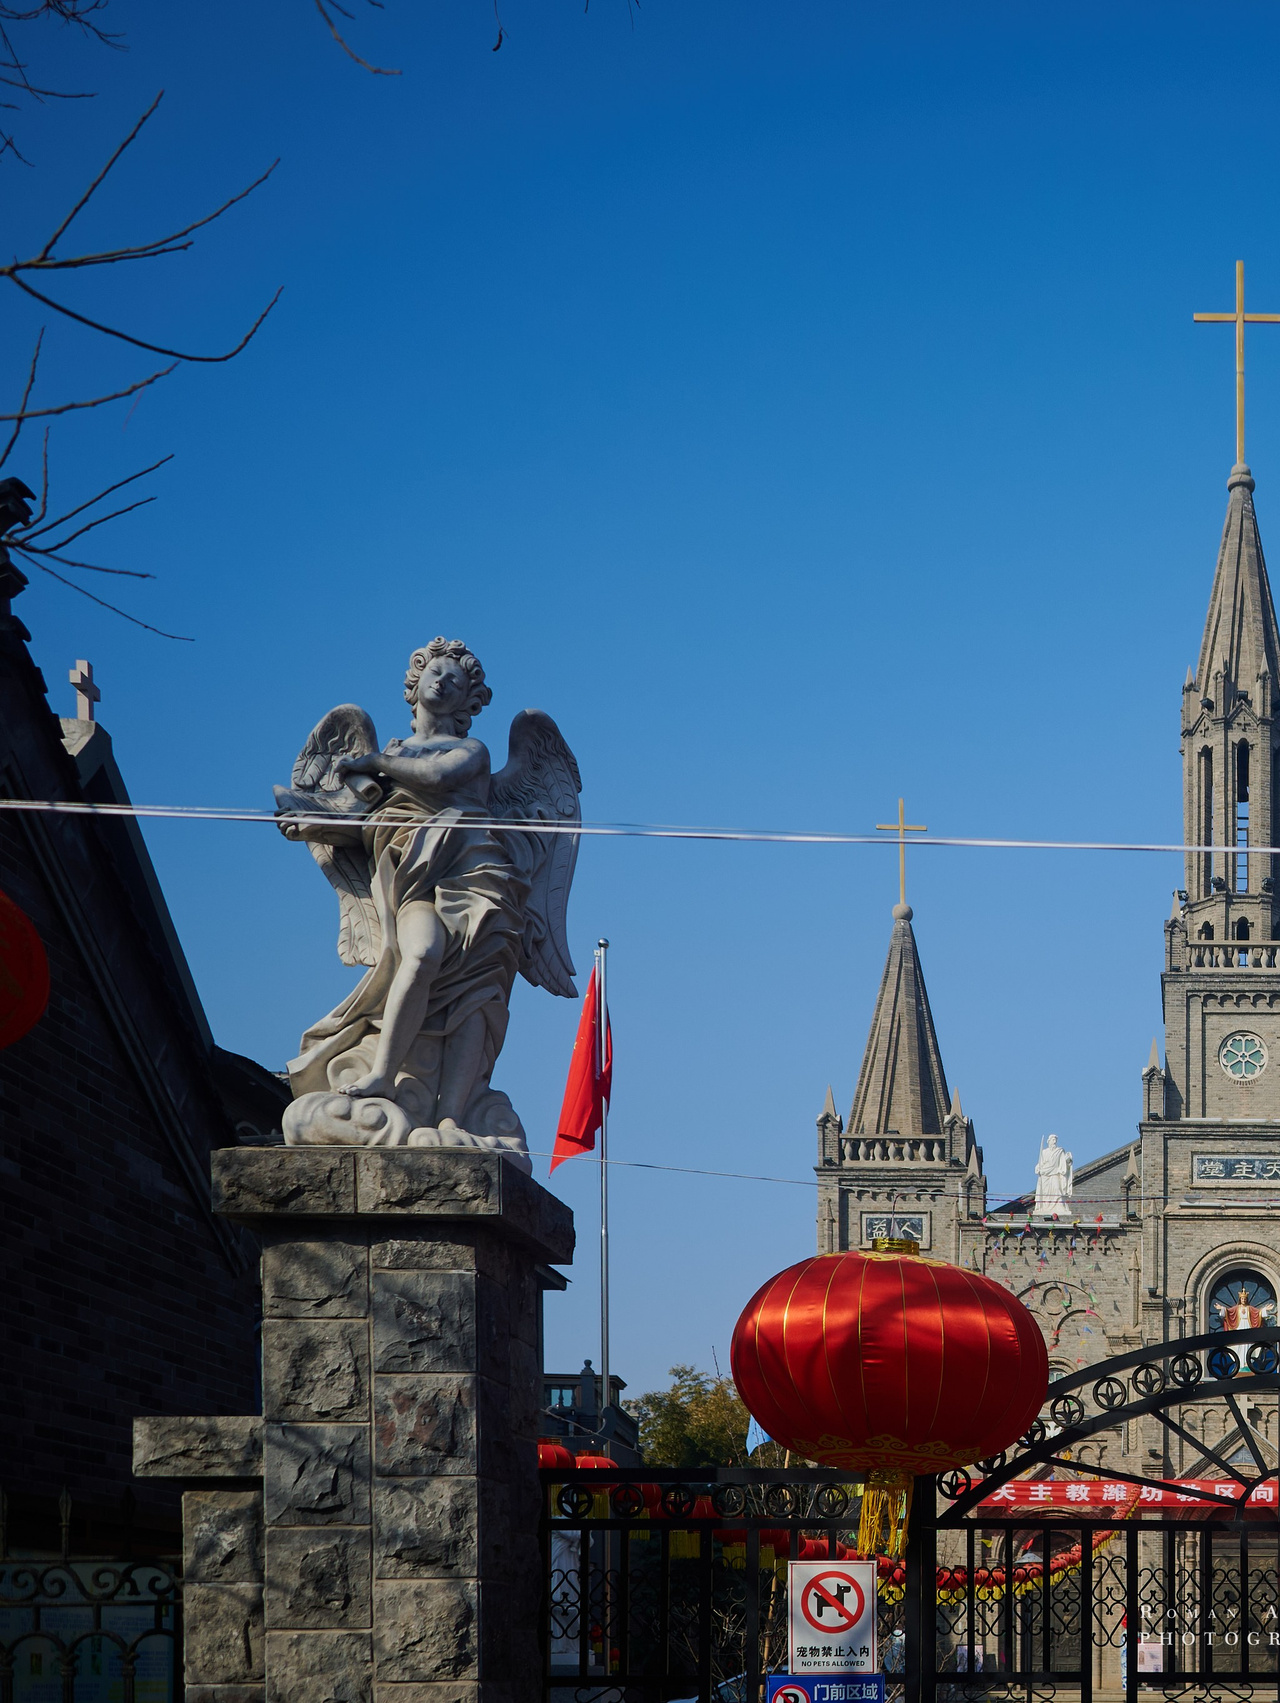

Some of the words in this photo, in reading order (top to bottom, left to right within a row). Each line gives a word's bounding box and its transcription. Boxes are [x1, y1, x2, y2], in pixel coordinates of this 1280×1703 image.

[796, 1645, 870, 1658] 宠物禁止入内
[814, 1683, 878, 1701] 门前区域
